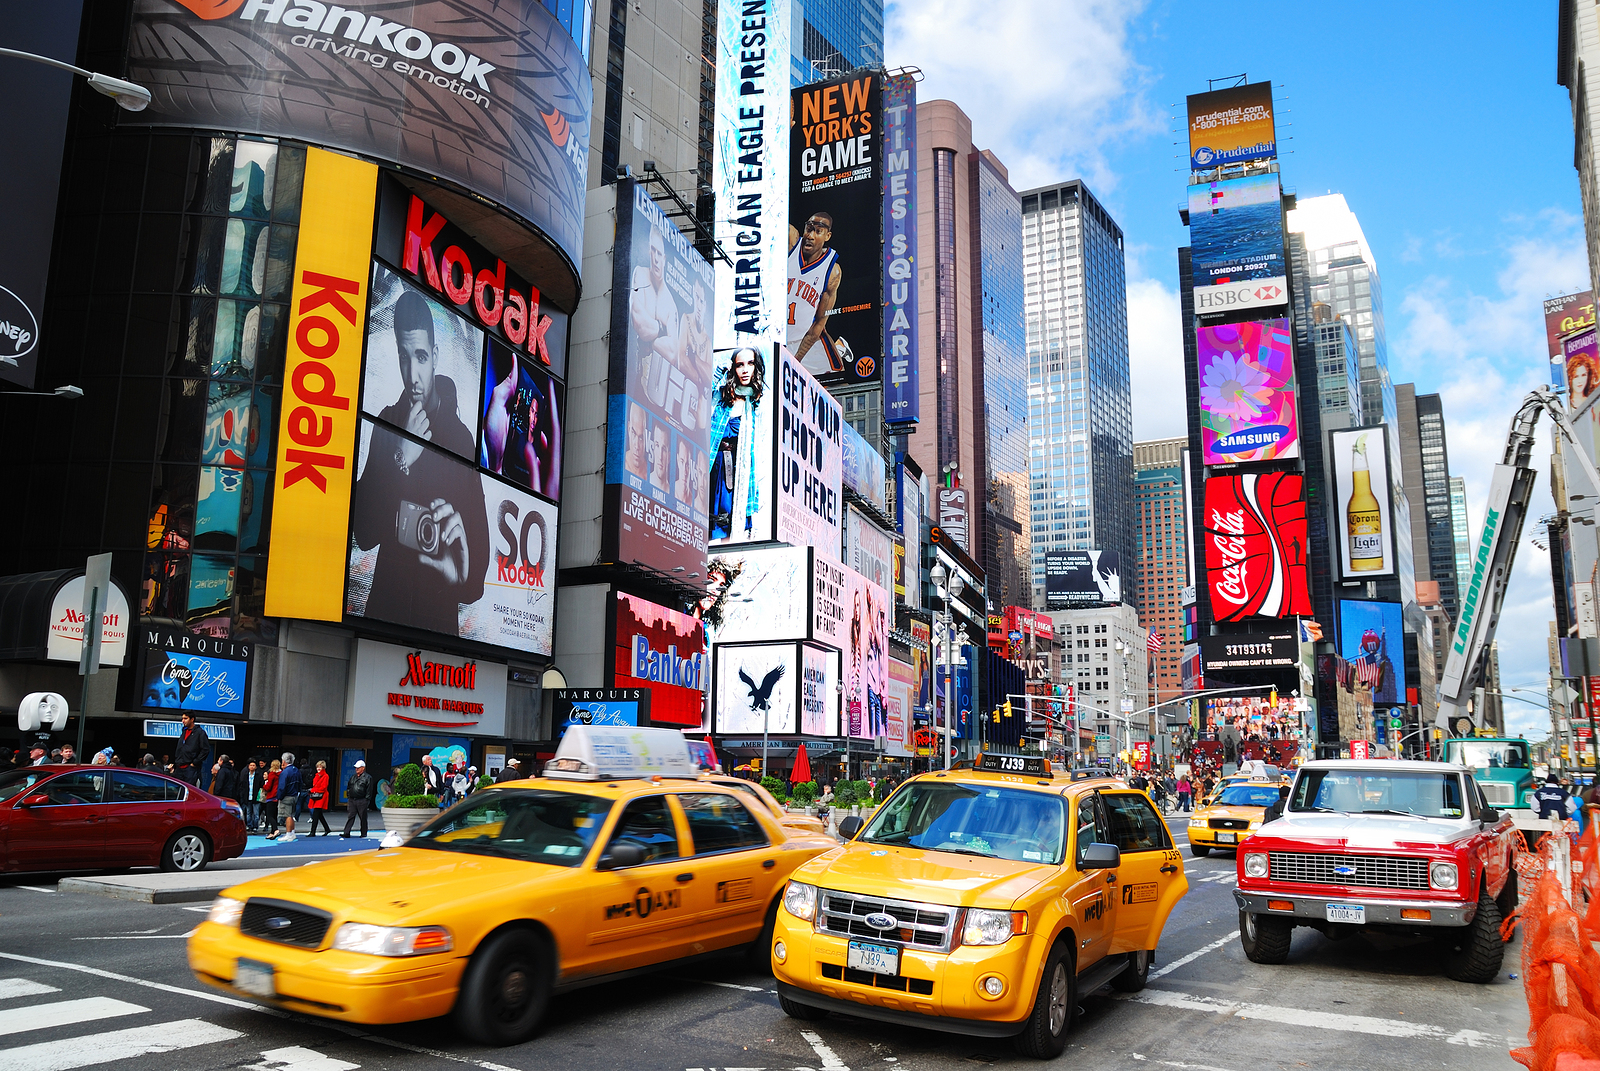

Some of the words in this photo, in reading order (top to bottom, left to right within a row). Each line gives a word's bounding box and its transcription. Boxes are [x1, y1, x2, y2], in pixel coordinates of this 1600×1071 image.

[290, 32, 389, 69] driving
[392, 61, 492, 109] emotion
[802, 76, 872, 127] NEW
[1191, 110, 1271, 132] 1-800-THE-ROCK
[1195, 104, 1264, 124] prudential.com
[802, 111, 872, 148] YORK'S
[737, 105, 765, 184] EAGLE
[801, 133, 872, 177] GAME
[1215, 140, 1274, 162] Prudential
[888, 104, 910, 221] TIMES
[815, 180, 834, 190] CHANCE
[734, 200, 763, 335] AMERICAN
[1209, 264, 1243, 276] LONDON
[1240, 253, 1277, 265] STADIUM
[402, 194, 555, 367] Kodak
[842, 302, 872, 314] STOUDEMIRE
[888, 233, 911, 385] SQUARE
[1198, 288, 1251, 308] HSBC
[1544, 295, 1577, 308] NATHAN
[1545, 305, 1564, 315] LANE
[0, 320, 31, 352] NEY
[282, 270, 361, 494] Kodak
[646, 349, 700, 432] UFC
[782, 360, 807, 415] GET
[810, 386, 840, 448] YOUR
[891, 400, 909, 409] NYC
[782, 404, 823, 474] PHOTO
[1220, 432, 1281, 447] SAMSUNG
[781, 452, 800, 498] UP
[803, 469, 837, 527] HERE!
[623, 501, 644, 522] LIVE
[645, 512, 659, 530] ON
[631, 491, 652, 513] SAT.
[653, 504, 693, 535] OCTOBER
[693, 525, 704, 541] 23
[1349, 514, 1380, 526] Corona
[495, 499, 548, 577] SO
[1352, 536, 1380, 550] Light
[1211, 508, 1249, 605] Coca-Cola
[497, 556, 545, 588] Kodak
[816, 558, 829, 574] STEP
[829, 565, 845, 588] INSIDE
[1453, 507, 1500, 656] LANDMARK
[816, 577, 826, 593] FOR
[826, 582, 840, 604] YOUR
[493, 603, 510, 616] SHARE
[509, 607, 523, 619] YOUR
[816, 596, 822, 612] 15
[823, 600, 845, 623] SECONDS
[51, 624, 70, 633] NEW
[502, 616, 524, 629] MOMENT
[524, 622, 537, 632] HERE
[816, 614, 822, 631] OF
[823, 617, 836, 637] FAME
[147, 630, 250, 658] MARQUIS
[399, 651, 478, 691] Marriott
[631, 633, 682, 687] Bank
[681, 651, 702, 691] of
[161, 658, 192, 688] Come
[187, 657, 212, 690] Fly
[208, 671, 240, 708] Away
[803, 667, 825, 685] AMERICAN
[558, 689, 641, 700] MARQUIS
[803, 682, 817, 698] EAGLE
[387, 692, 412, 708] NEW
[413, 695, 442, 711] YORK
[441, 698, 485, 716] MARQUIS
[568, 705, 592, 725] Come
[587, 702, 608, 724] Fly
[803, 697, 825, 714] PRESENTS
[1000, 757, 1025, 771] 7J39
[1137, 743, 1149, 763] tkts
[1162, 850, 1182, 861] 7J39
[871, 917, 889, 926] Ford
[815, 946, 847, 958] ESCAPE
